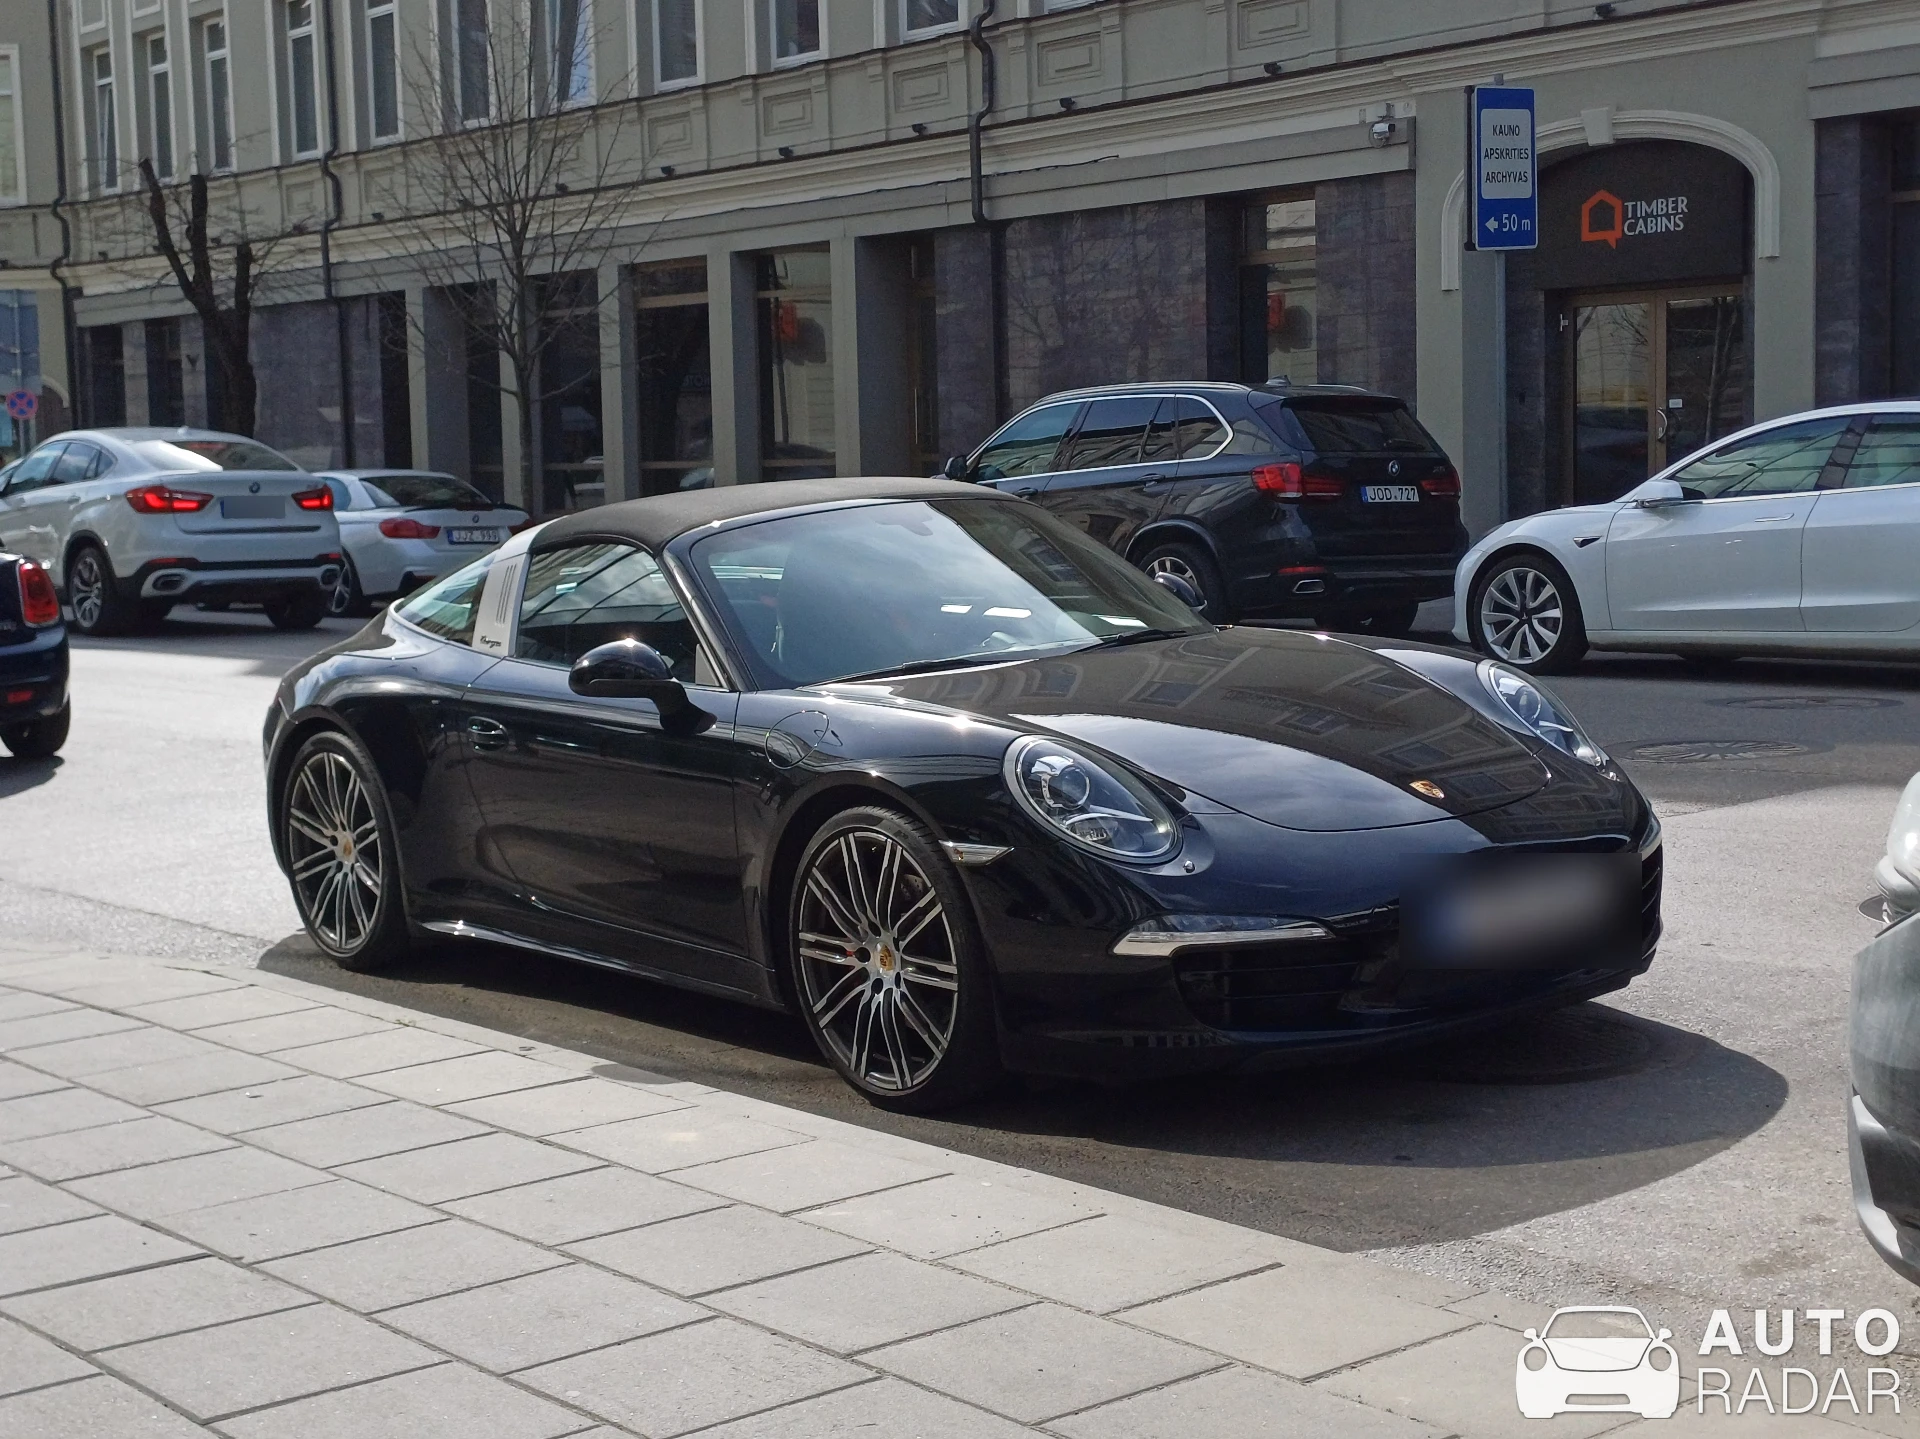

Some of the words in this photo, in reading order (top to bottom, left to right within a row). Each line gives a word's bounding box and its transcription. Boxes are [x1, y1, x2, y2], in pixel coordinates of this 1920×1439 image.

[1492, 124, 1520, 137] KAUNO
[1483, 147, 1529, 160] APSKRITIES
[1485, 171, 1529, 183] ARCHYVAS
[1624, 196, 1689, 218] TIMBER
[1502, 213, 1518, 232] 50
[1521, 219, 1531, 231] m
[1623, 214, 1685, 236] CABINS
[1369, 487, 1393, 501] JOD
